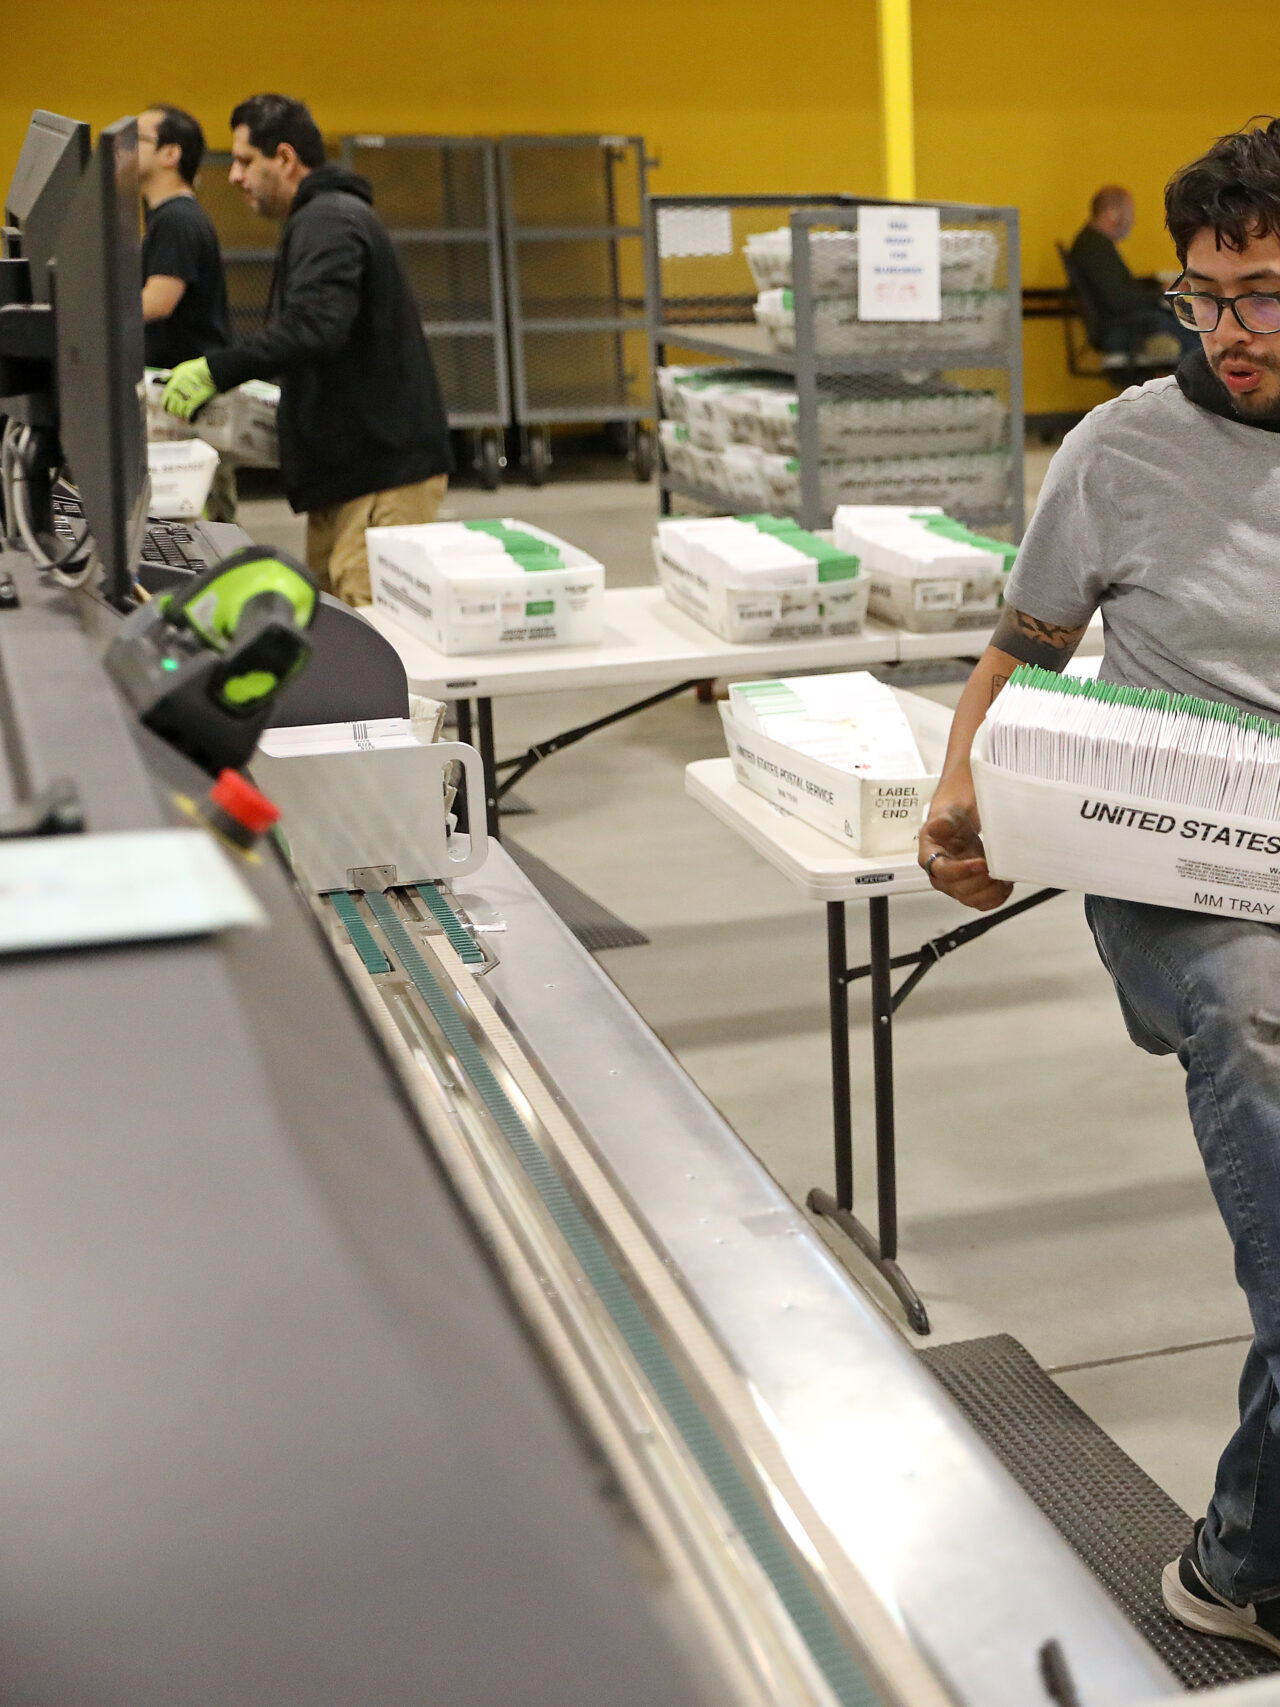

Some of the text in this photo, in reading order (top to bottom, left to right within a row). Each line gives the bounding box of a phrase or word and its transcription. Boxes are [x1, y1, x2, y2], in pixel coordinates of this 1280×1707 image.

[805, 778, 834, 805] SERVICE
[878, 787, 918, 797] LABEL
[875, 799, 919, 808] OTHER
[882, 809, 909, 819] END
[1080, 799, 1176, 834] UNITED
[1193, 892, 1223, 908] MM
[1228, 898, 1276, 916] TRAY
